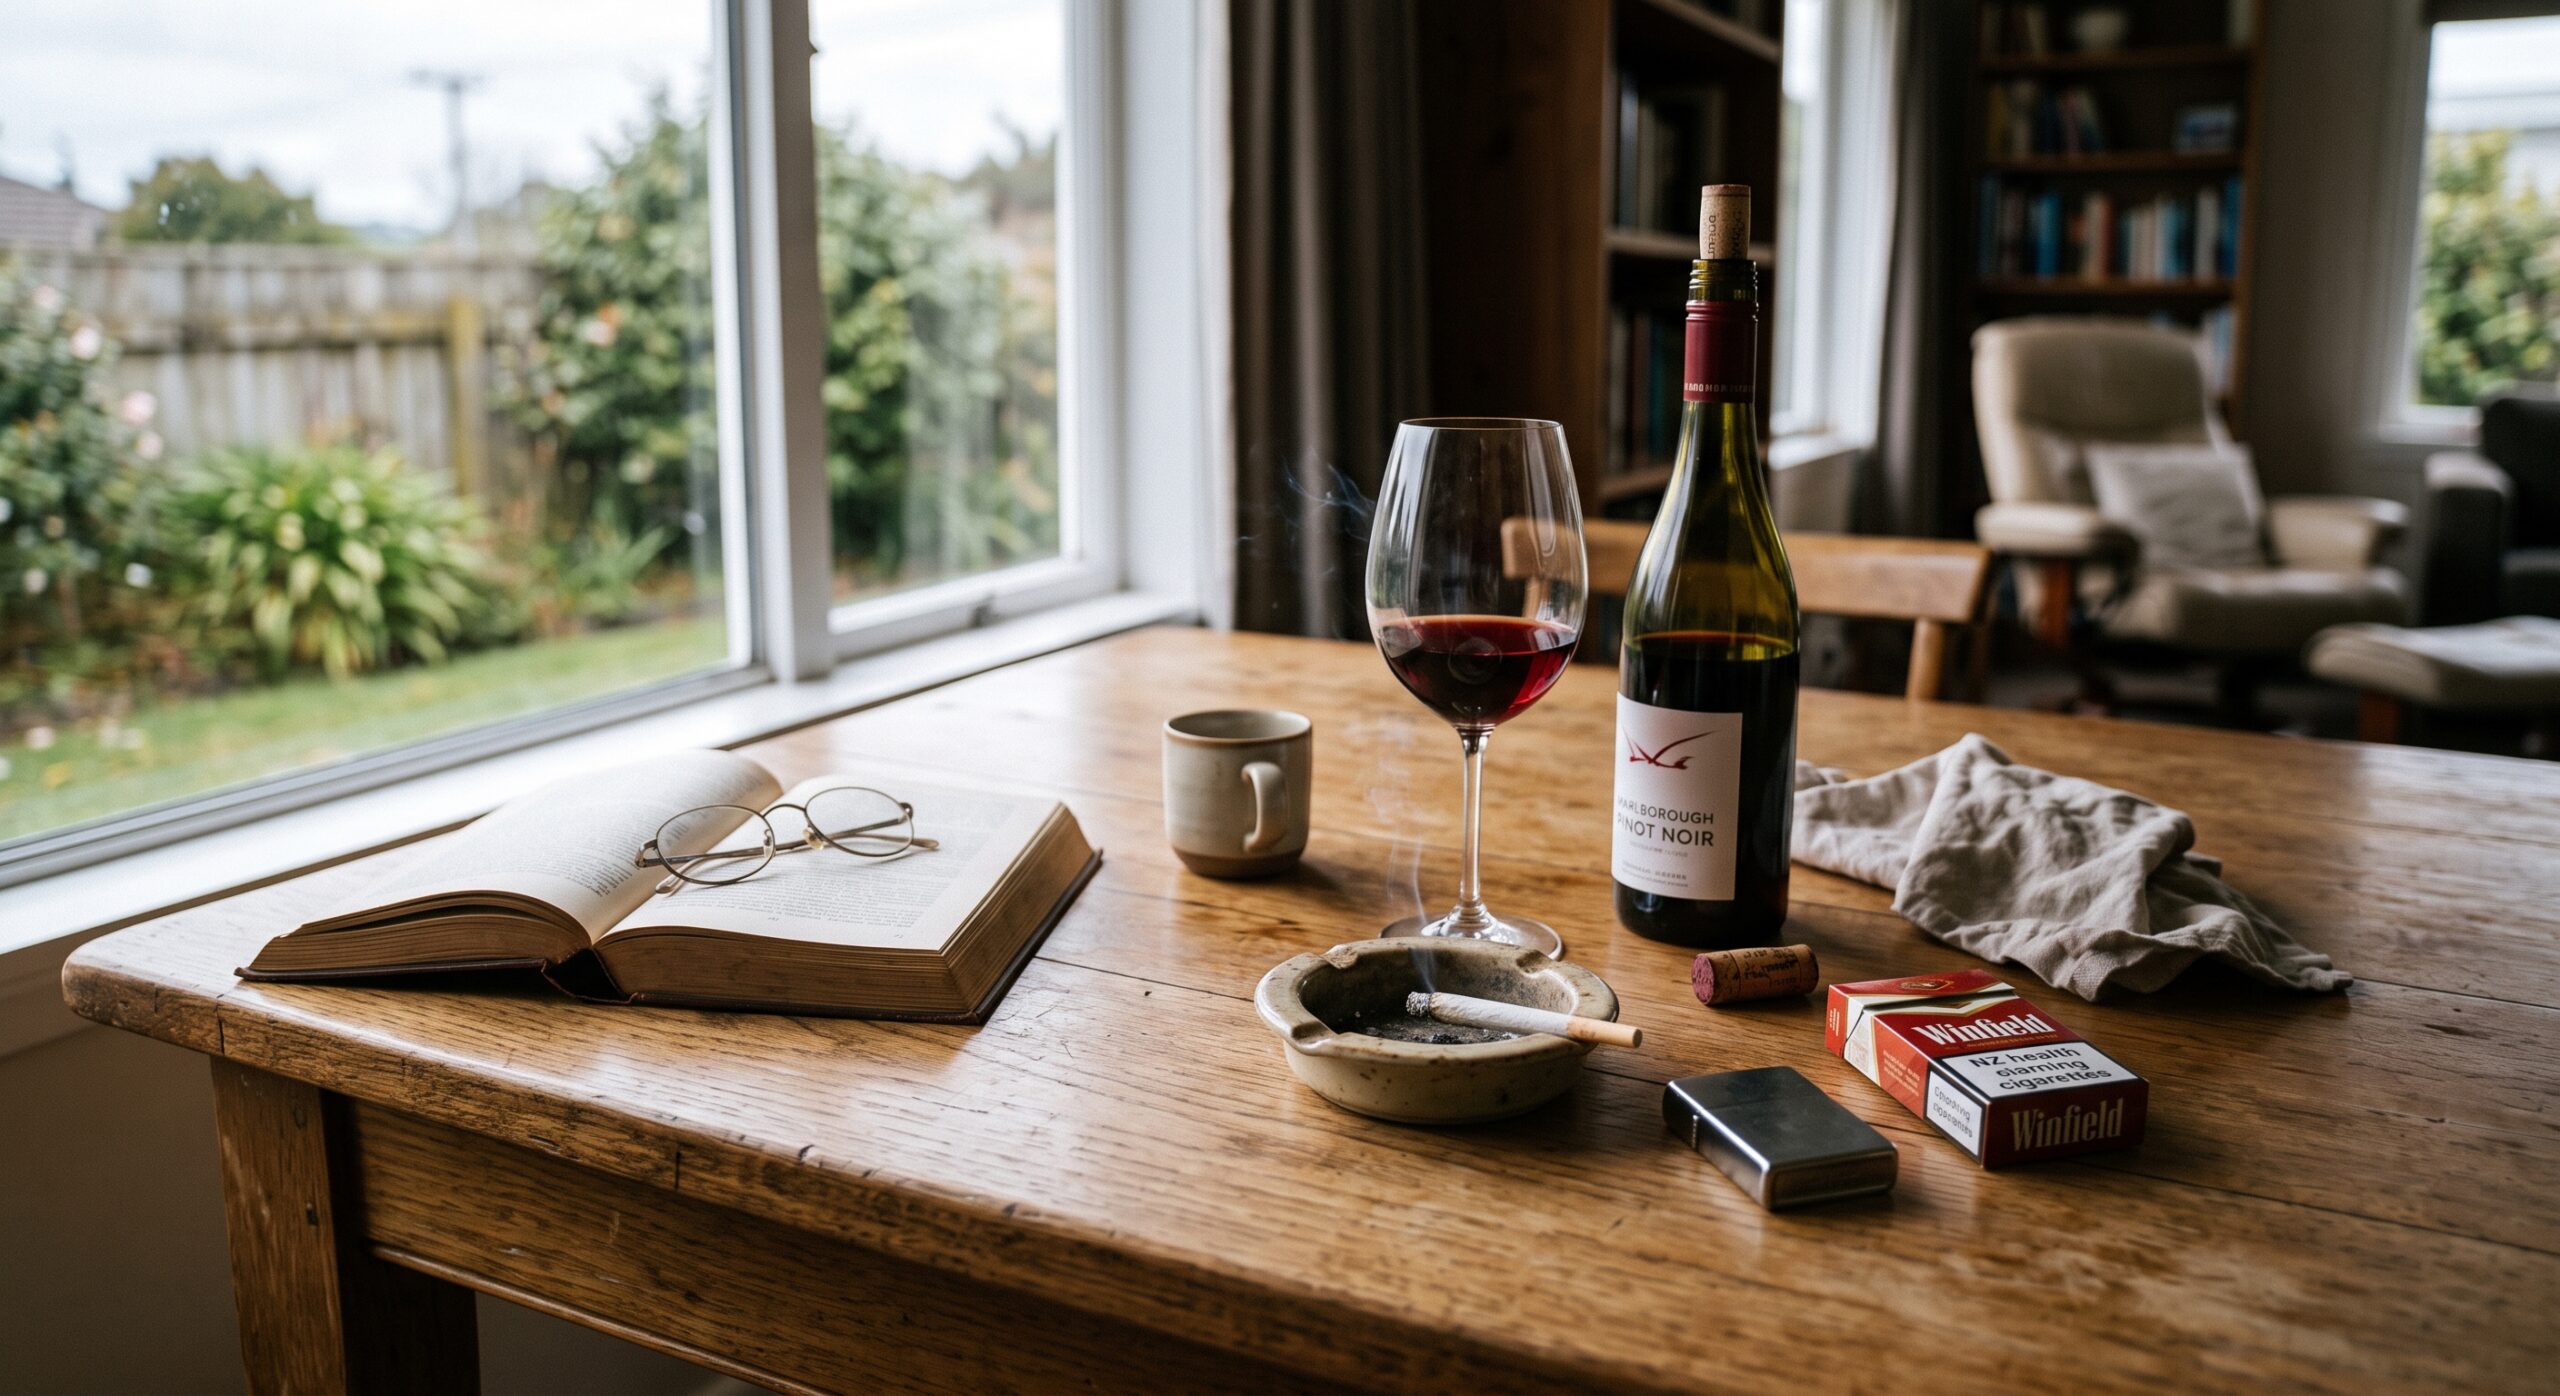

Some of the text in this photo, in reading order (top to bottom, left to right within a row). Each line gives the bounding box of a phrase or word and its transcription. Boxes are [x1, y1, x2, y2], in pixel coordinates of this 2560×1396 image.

[1617, 812, 1715, 847] PINOT NOIR
[1911, 1013, 2056, 1046] Winfield
[1968, 1047, 2081, 1068] NZ health
[1999, 1069, 2112, 1090] cigarettes
[2011, 1097, 2124, 1152] Winfield
